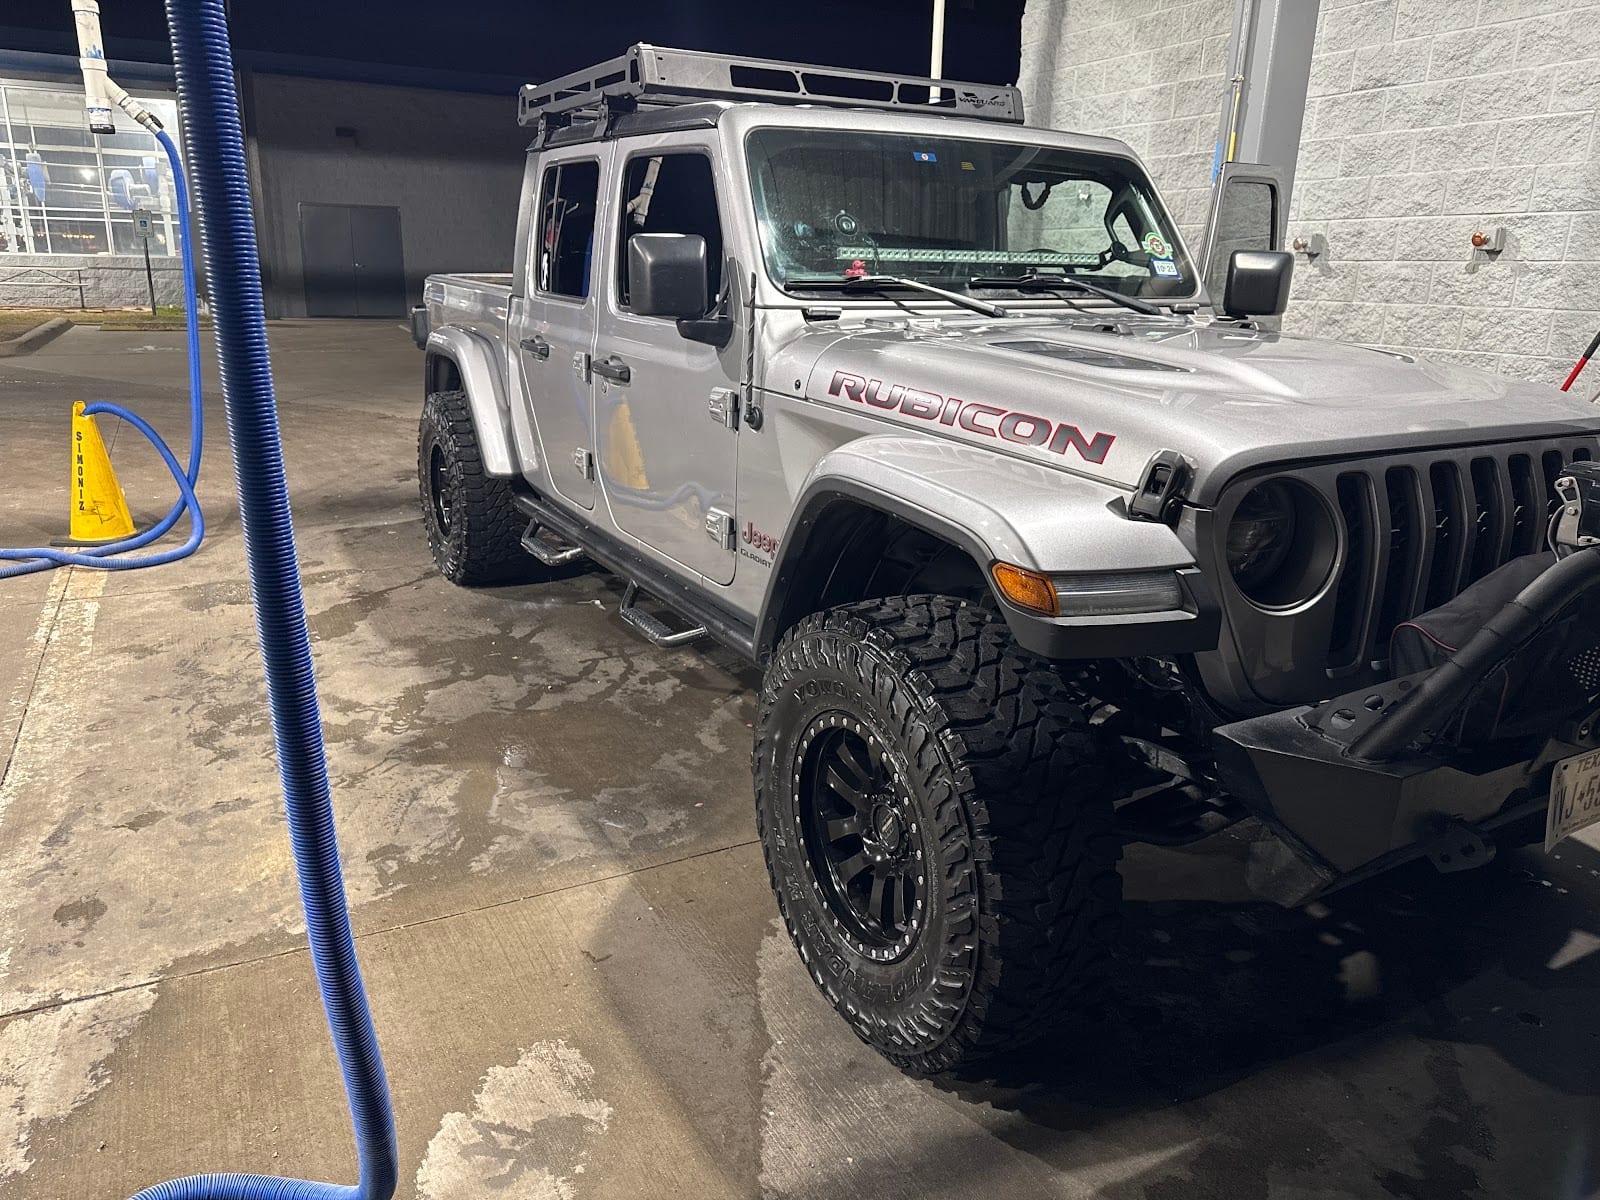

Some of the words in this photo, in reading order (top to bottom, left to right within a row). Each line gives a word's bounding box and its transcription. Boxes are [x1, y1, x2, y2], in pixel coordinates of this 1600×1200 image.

[828, 370, 1116, 465] RUBICON
[76, 431, 84, 511] SIMONIZ
[1577, 752, 1600, 774] TEX
